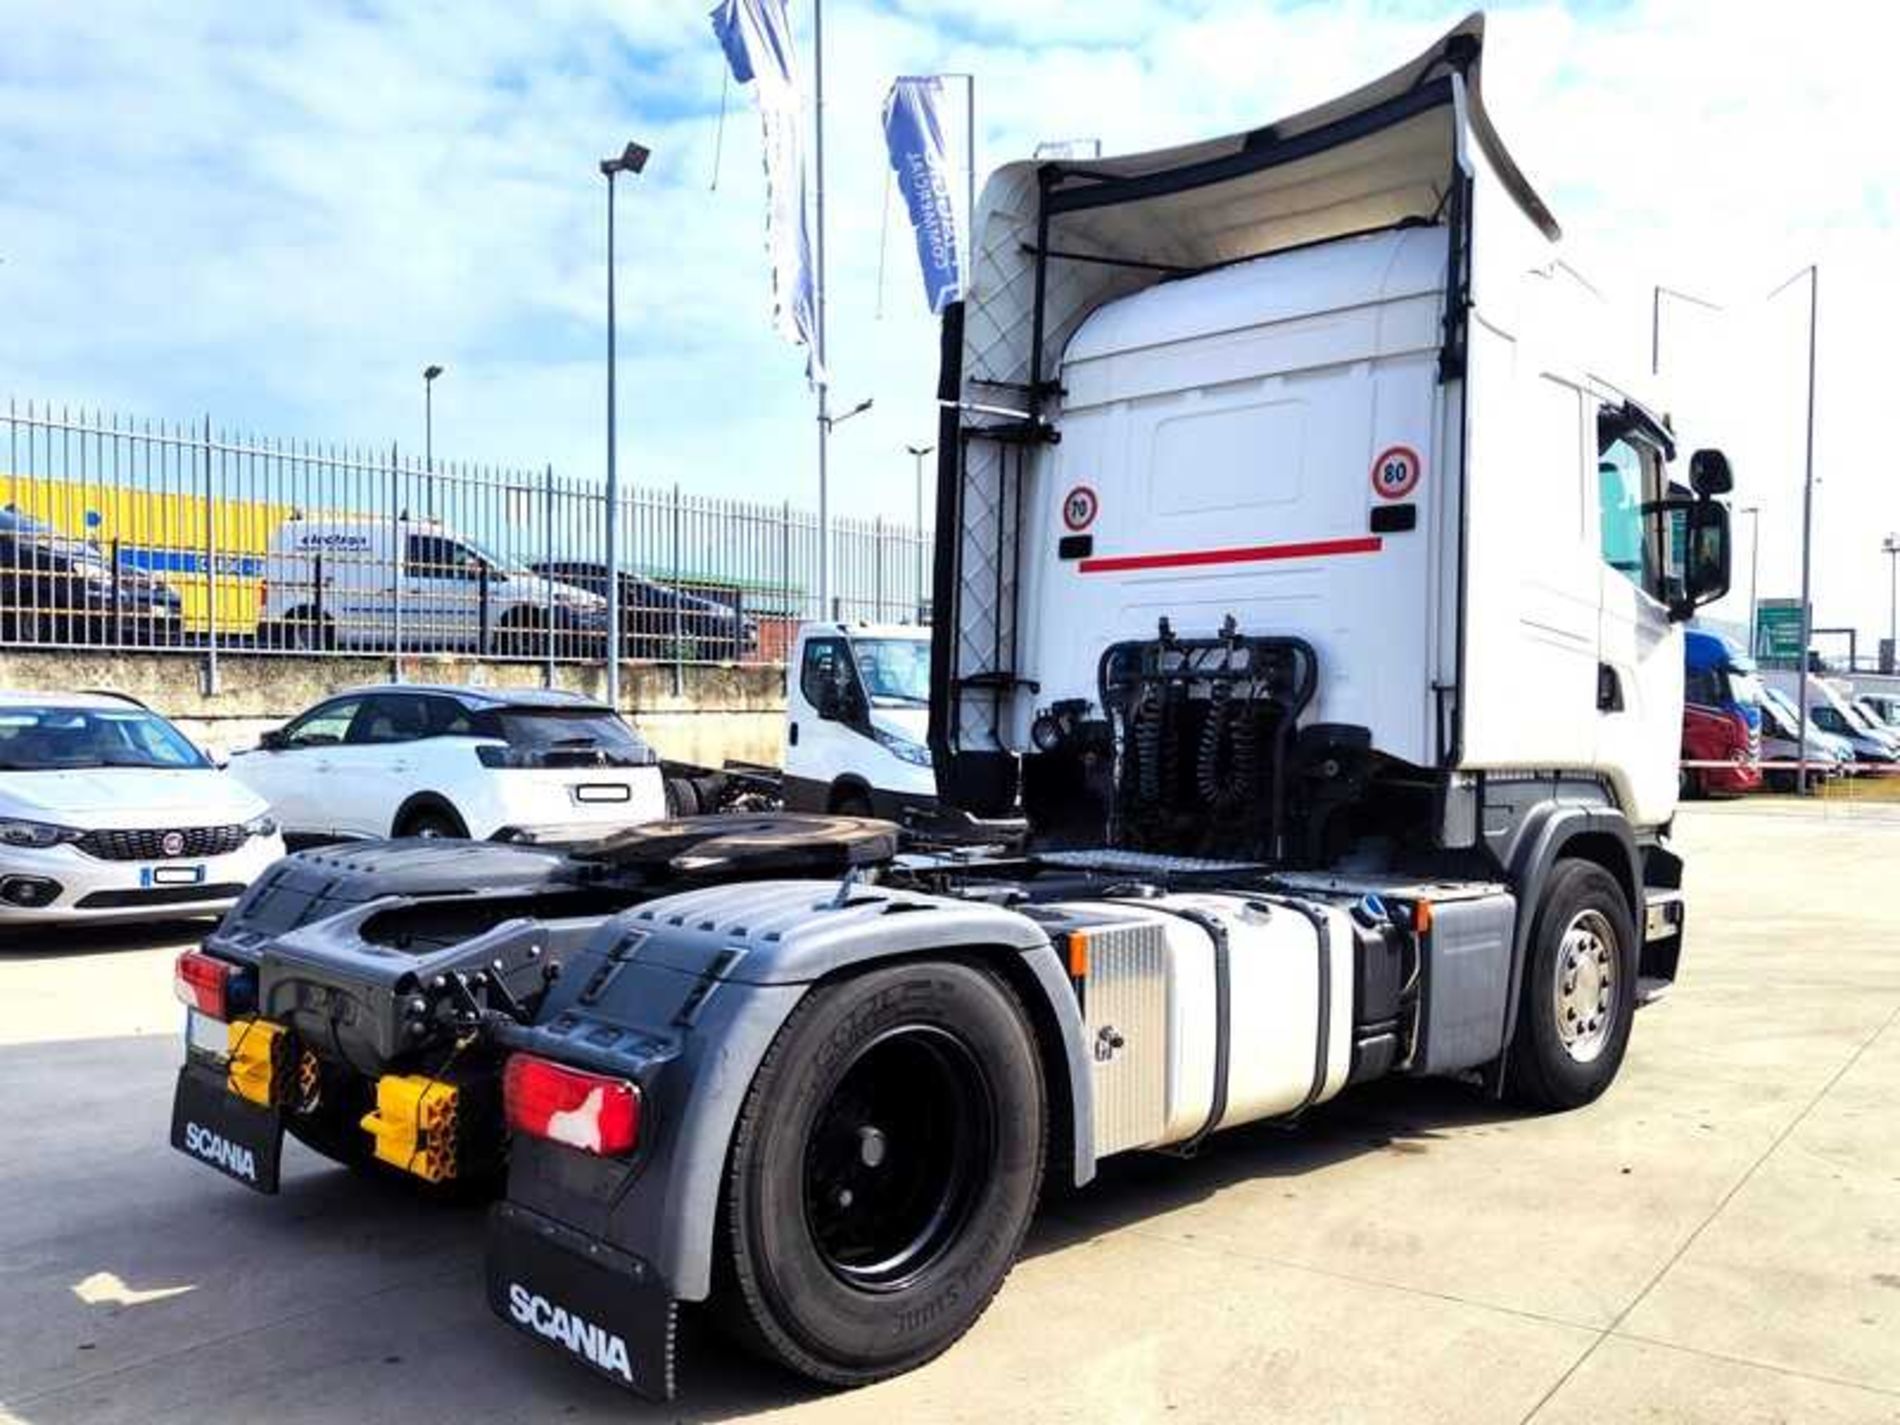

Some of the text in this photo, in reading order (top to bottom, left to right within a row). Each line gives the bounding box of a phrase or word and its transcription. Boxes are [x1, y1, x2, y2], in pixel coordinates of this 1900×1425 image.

[1383, 462, 1407, 485] 80
[1072, 499, 1088, 519] 70
[186, 1121, 257, 1181] SCANIA
[509, 1283, 633, 1383] SCANIA
